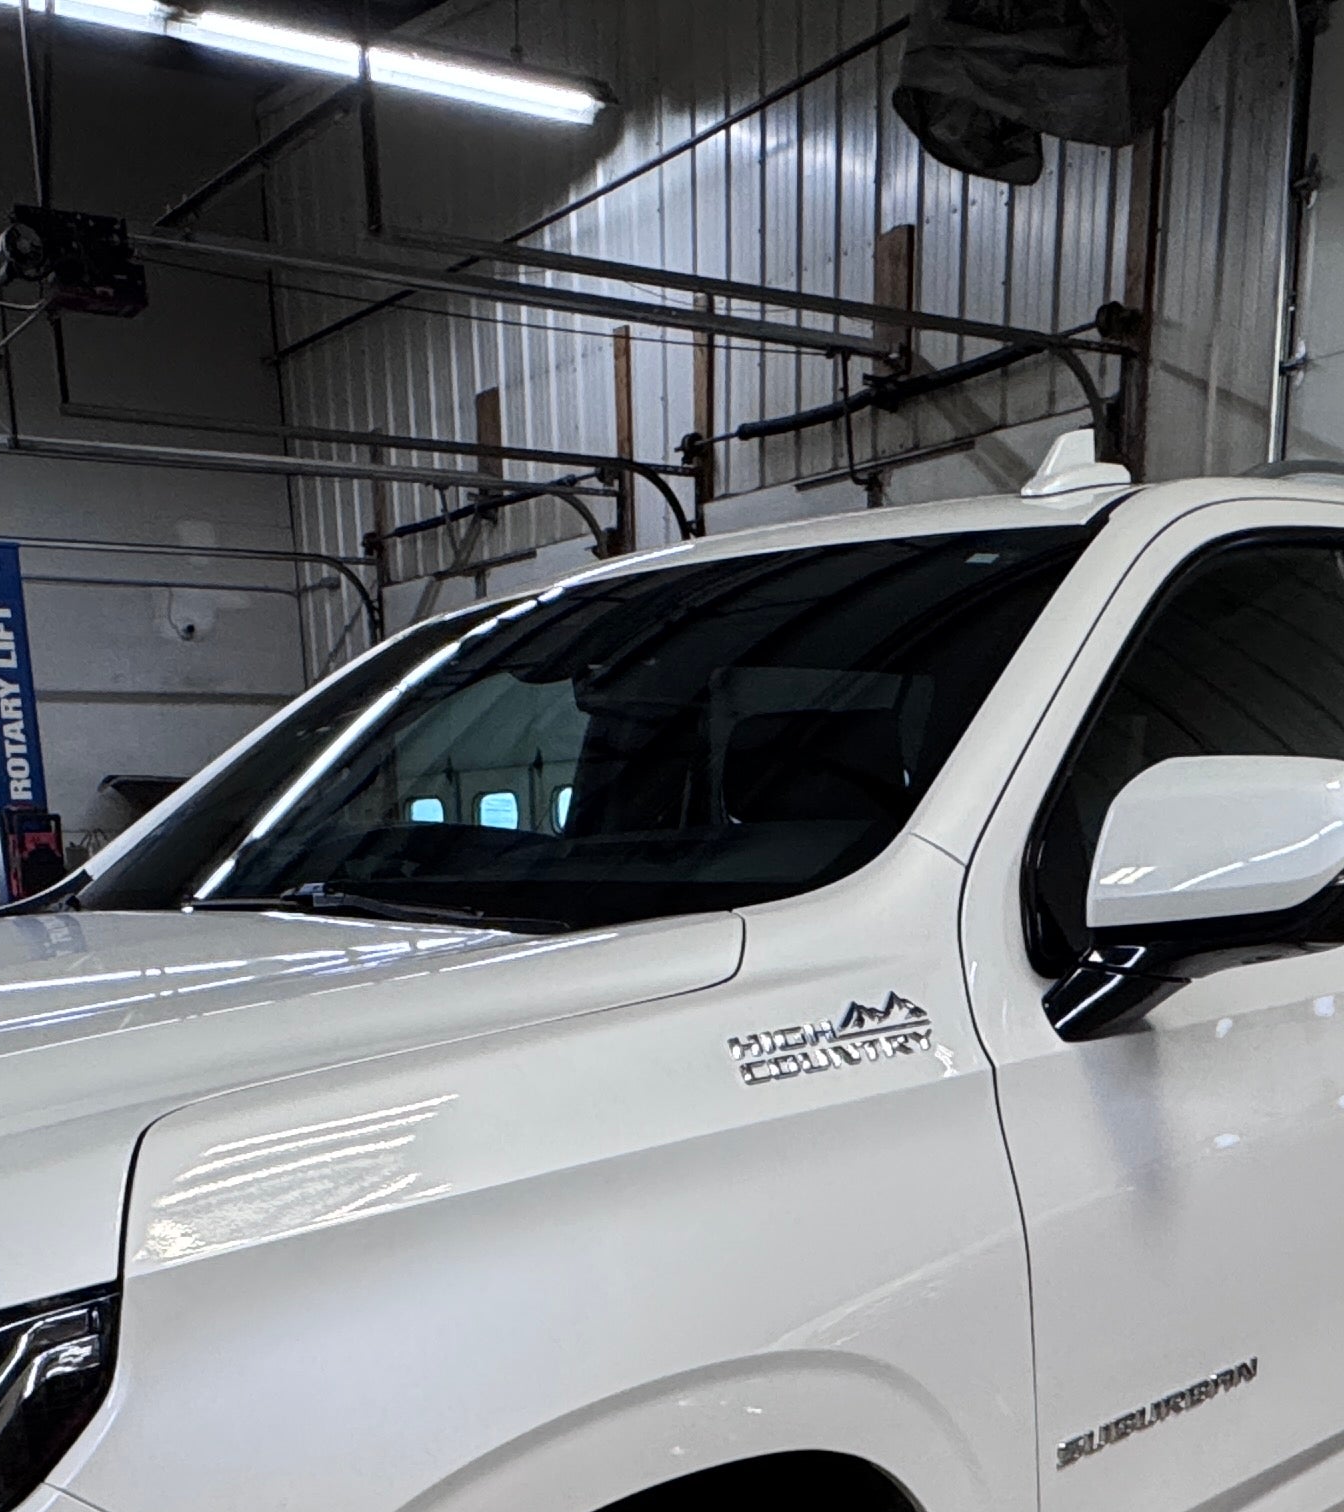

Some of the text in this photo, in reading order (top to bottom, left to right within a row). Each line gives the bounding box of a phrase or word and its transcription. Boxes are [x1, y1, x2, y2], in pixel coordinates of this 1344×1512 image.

[727, 1020, 837, 1061] HIGH
[739, 1028, 933, 1086] COUNTRY
[1056, 1356, 1259, 1472] SUBURBAN
